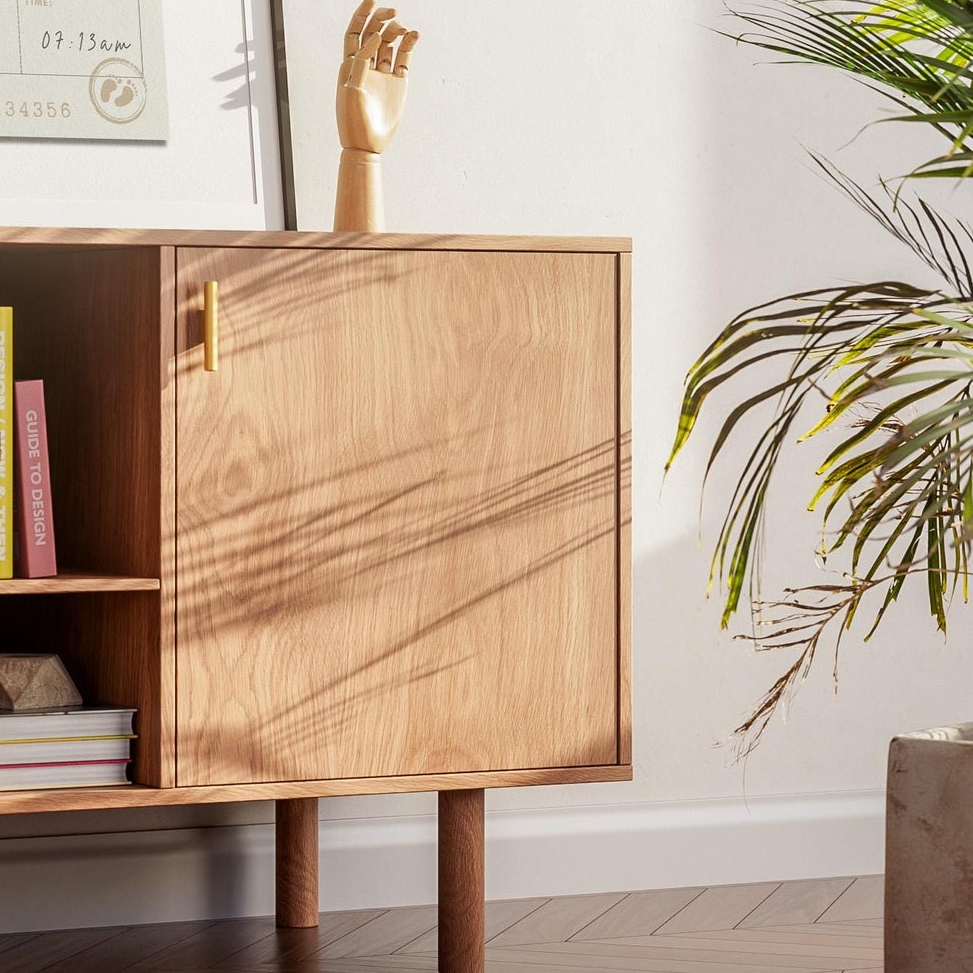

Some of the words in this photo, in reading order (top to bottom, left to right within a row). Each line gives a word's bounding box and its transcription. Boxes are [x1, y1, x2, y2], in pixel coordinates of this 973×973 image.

[26, 409, 40, 458] GUIDE
[30, 463, 42, 485] TO
[31, 488, 46, 546] DESIGN
